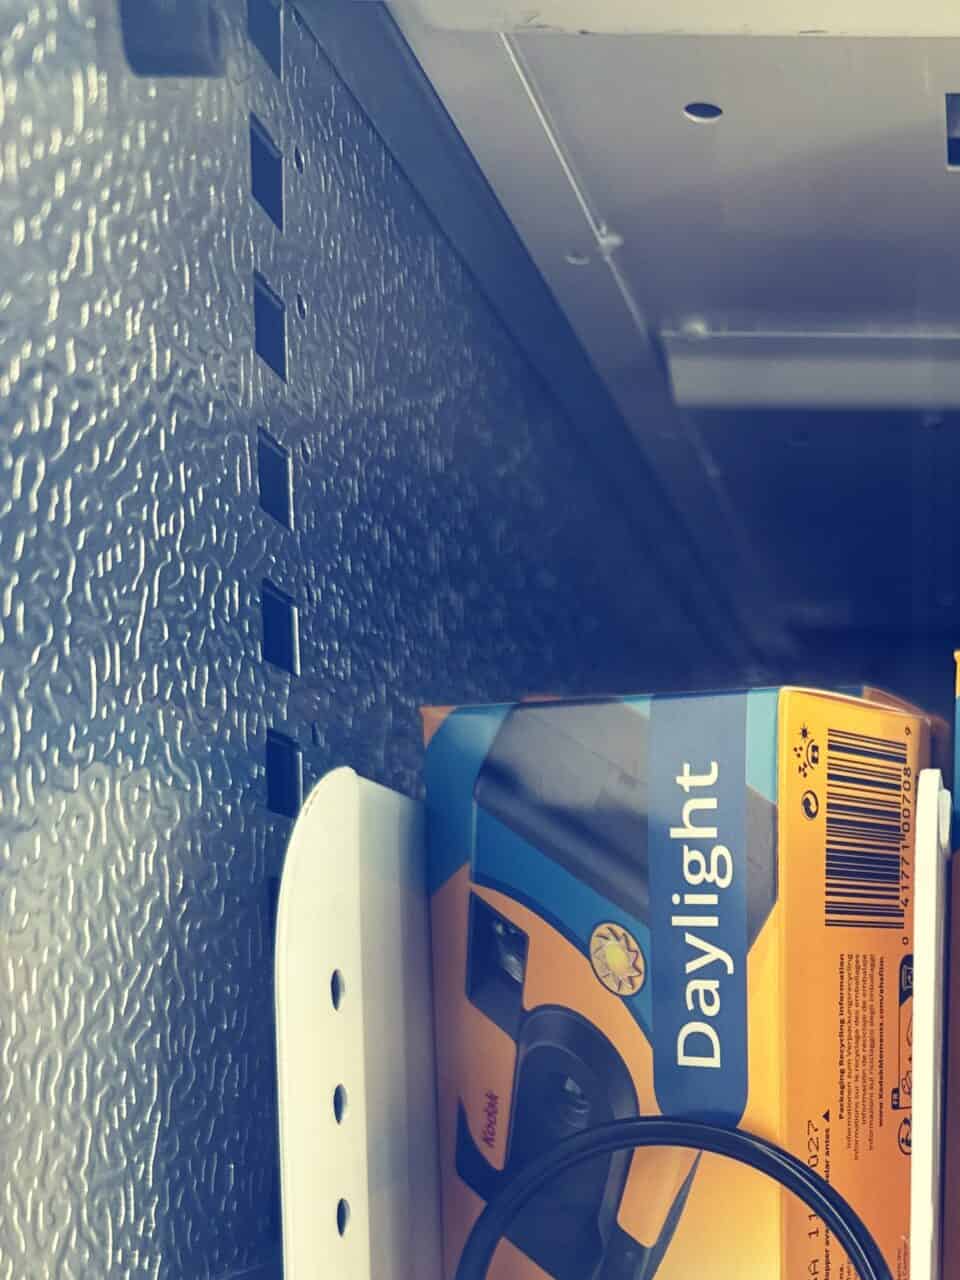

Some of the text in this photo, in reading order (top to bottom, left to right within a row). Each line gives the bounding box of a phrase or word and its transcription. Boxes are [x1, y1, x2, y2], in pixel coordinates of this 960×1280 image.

[901, 767, 911, 833] 00708
[902, 844, 910, 907] 41771
[669, 761, 734, 1069] Daylight
